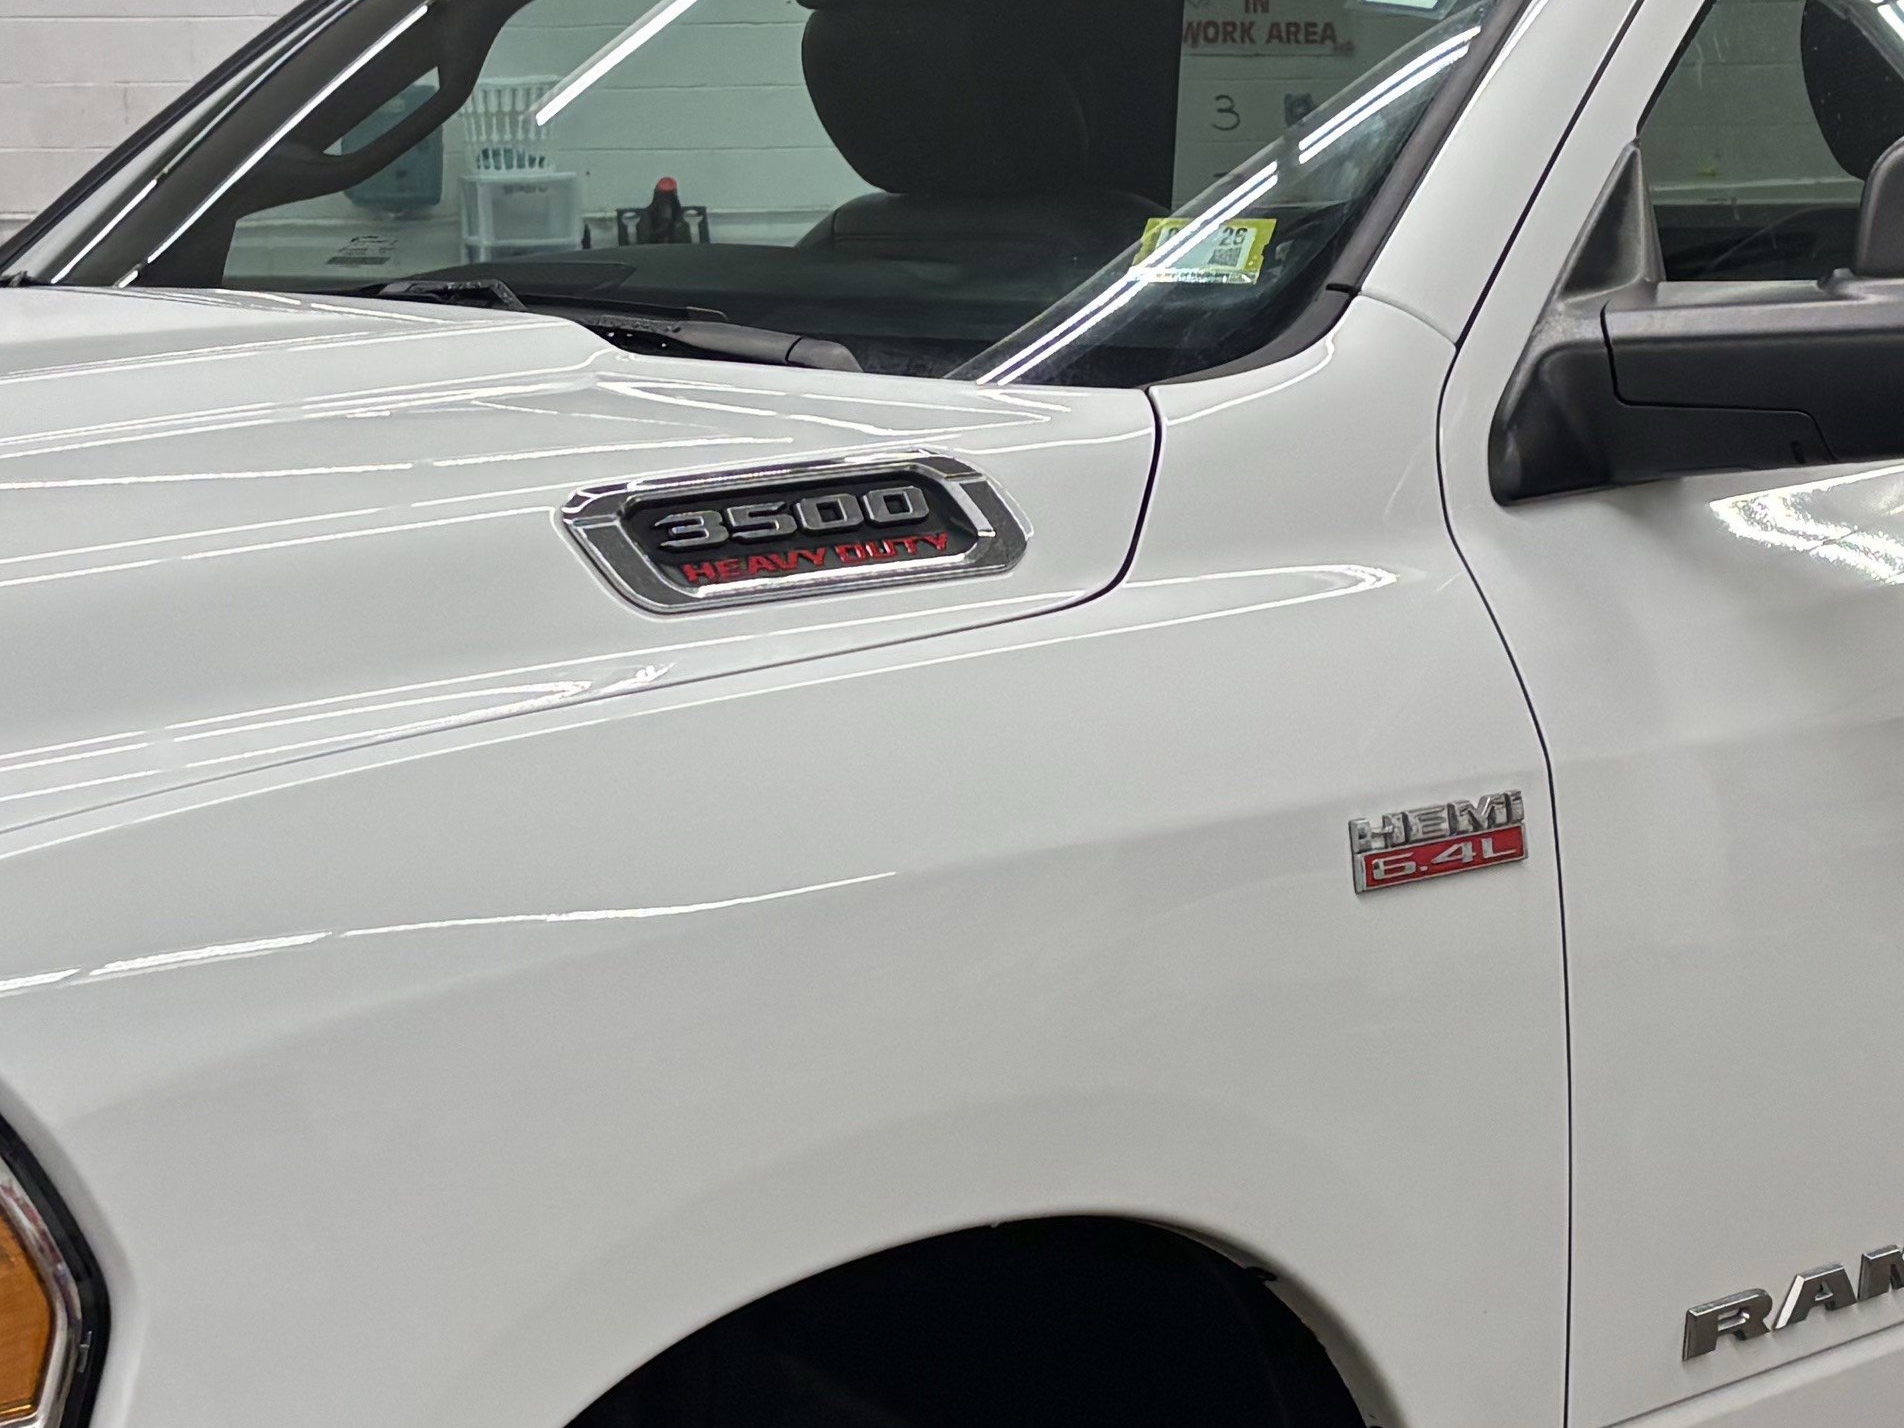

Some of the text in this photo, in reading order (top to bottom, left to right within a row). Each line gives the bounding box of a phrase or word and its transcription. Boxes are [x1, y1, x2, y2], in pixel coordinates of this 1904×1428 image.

[1266, 22, 1337, 45] AREA
[1210, 95, 1241, 131] 3
[654, 485, 931, 553] 3500
[682, 531, 948, 583] HEAVY DUTY
[1349, 789, 1525, 853] HEMI
[1372, 838, 1517, 880] 6.4L
